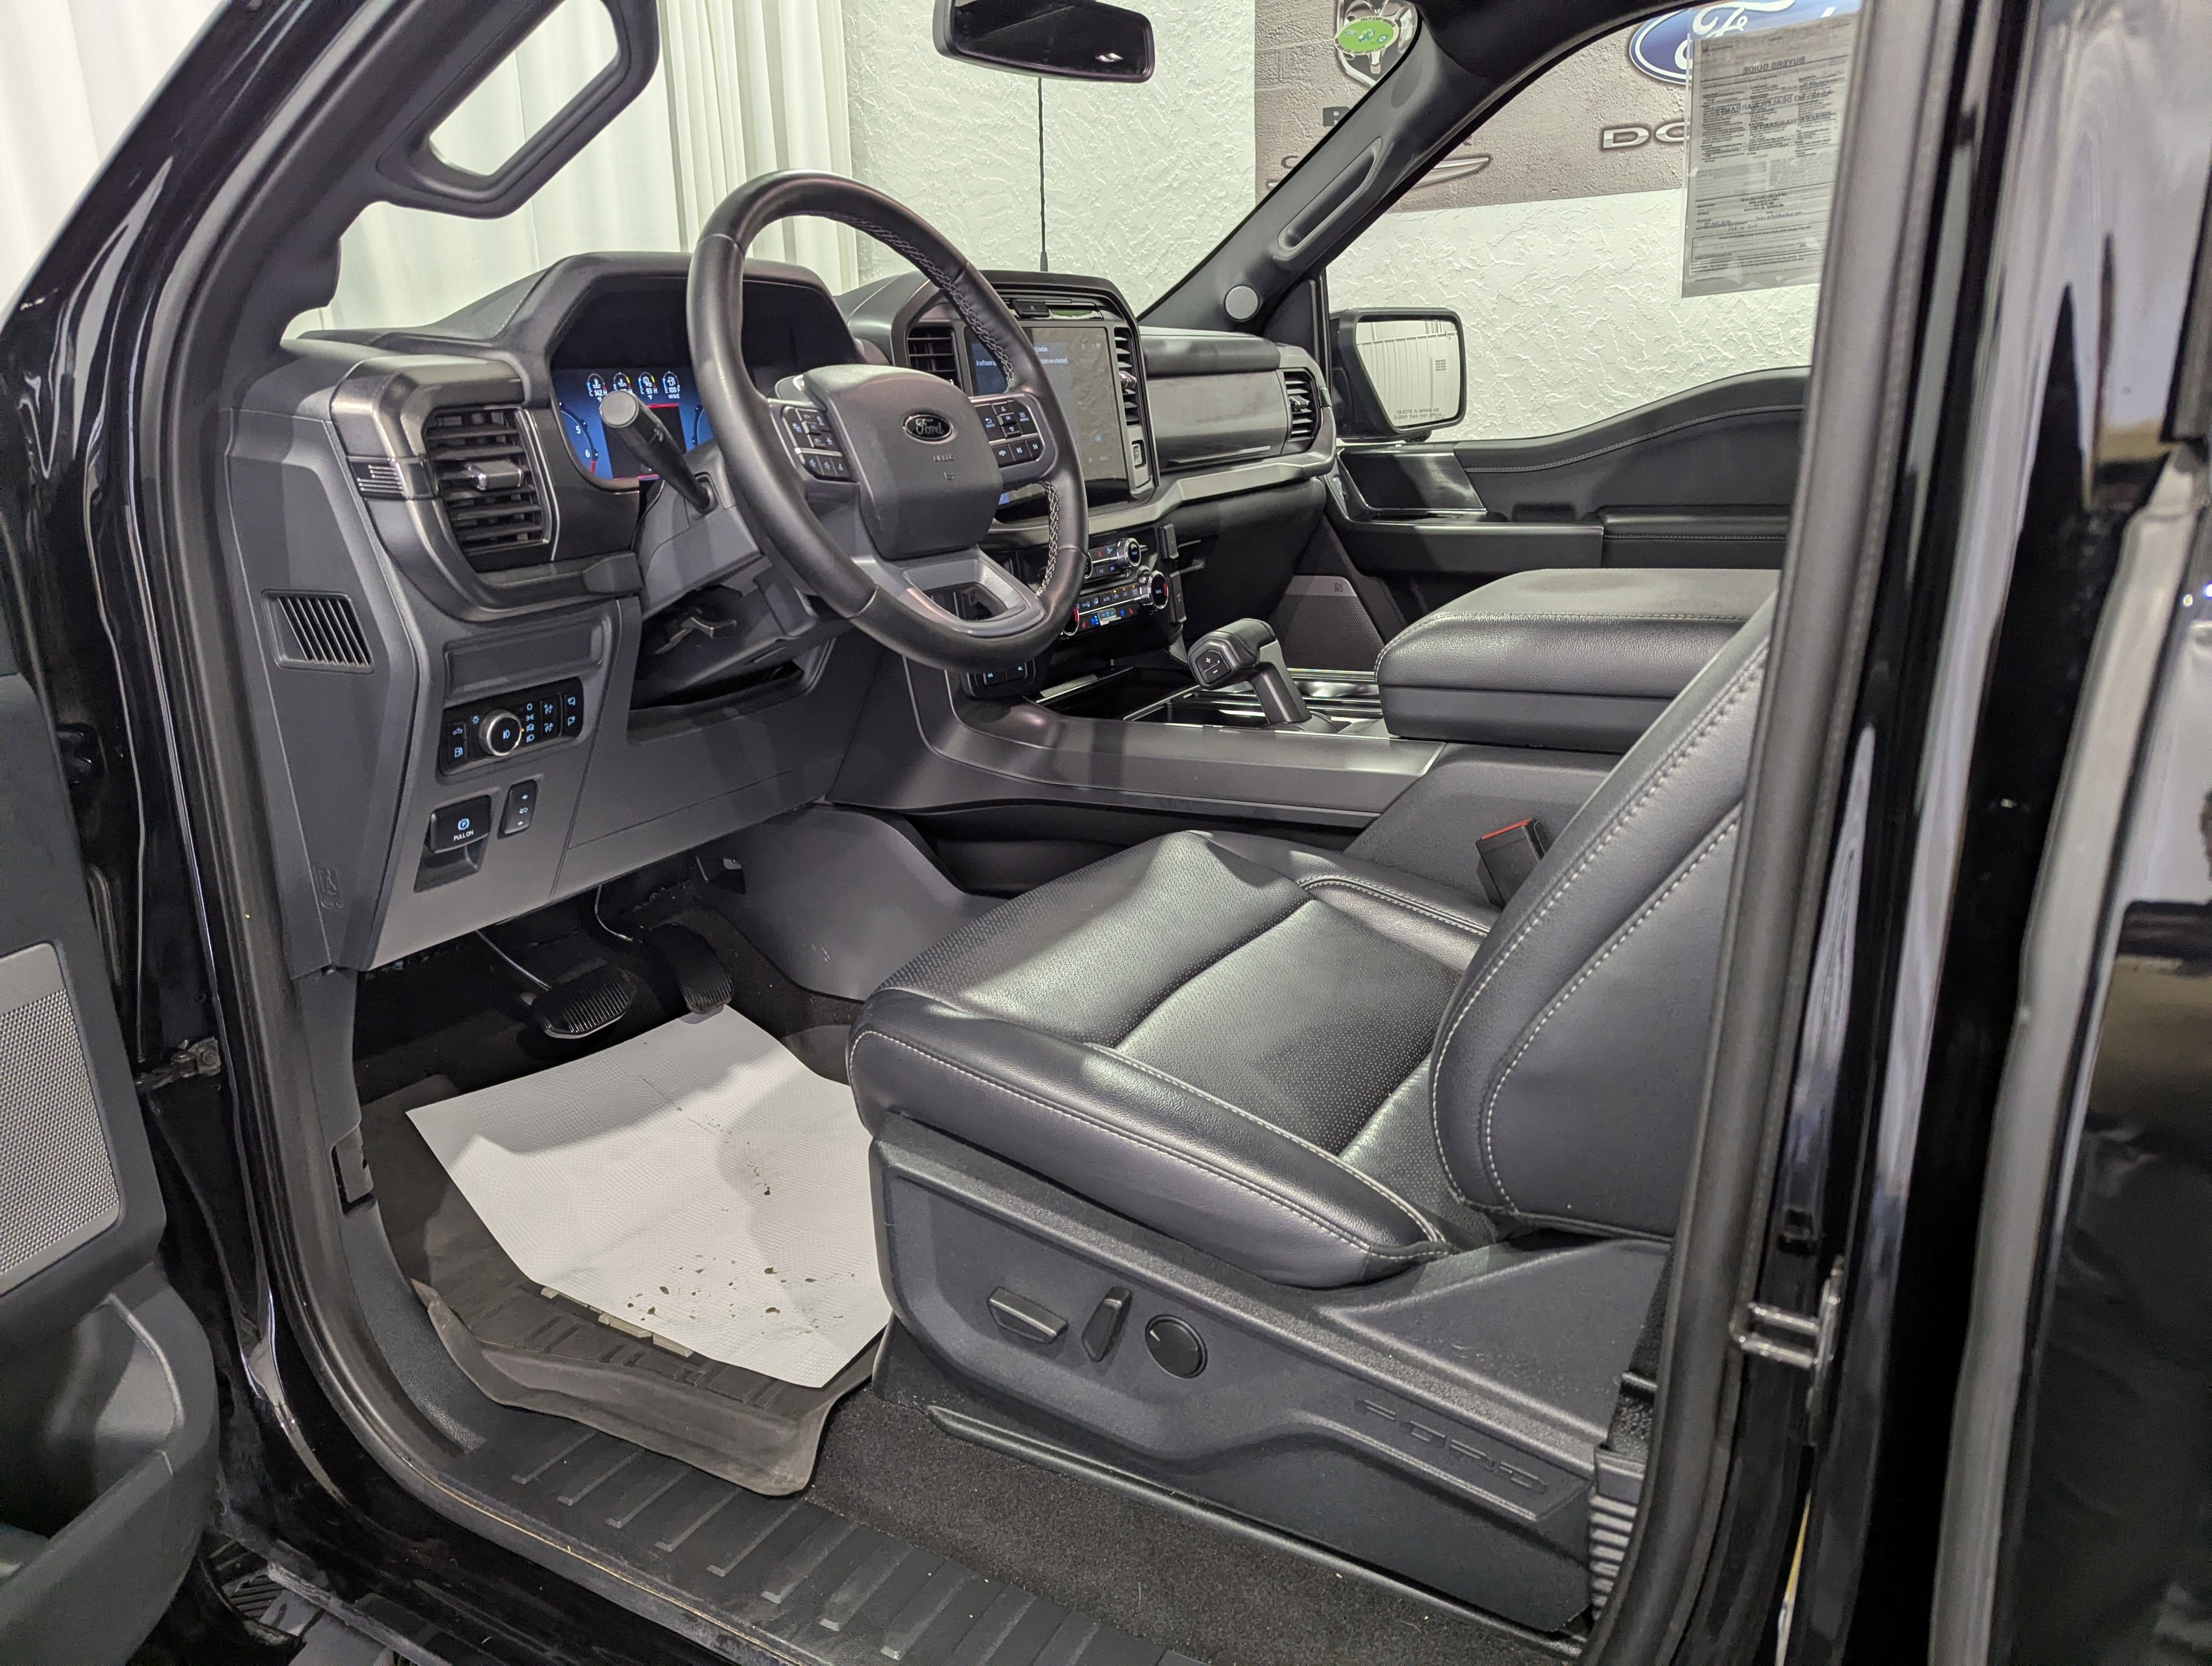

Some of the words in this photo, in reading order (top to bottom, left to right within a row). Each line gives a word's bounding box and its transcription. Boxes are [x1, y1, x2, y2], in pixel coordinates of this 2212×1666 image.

[575, 425, 581, 434] 5
[915, 418, 944, 434] Ford
[585, 449, 590, 458] 6
[453, 832, 466, 842] PULL
[466, 829, 474, 837] ON
